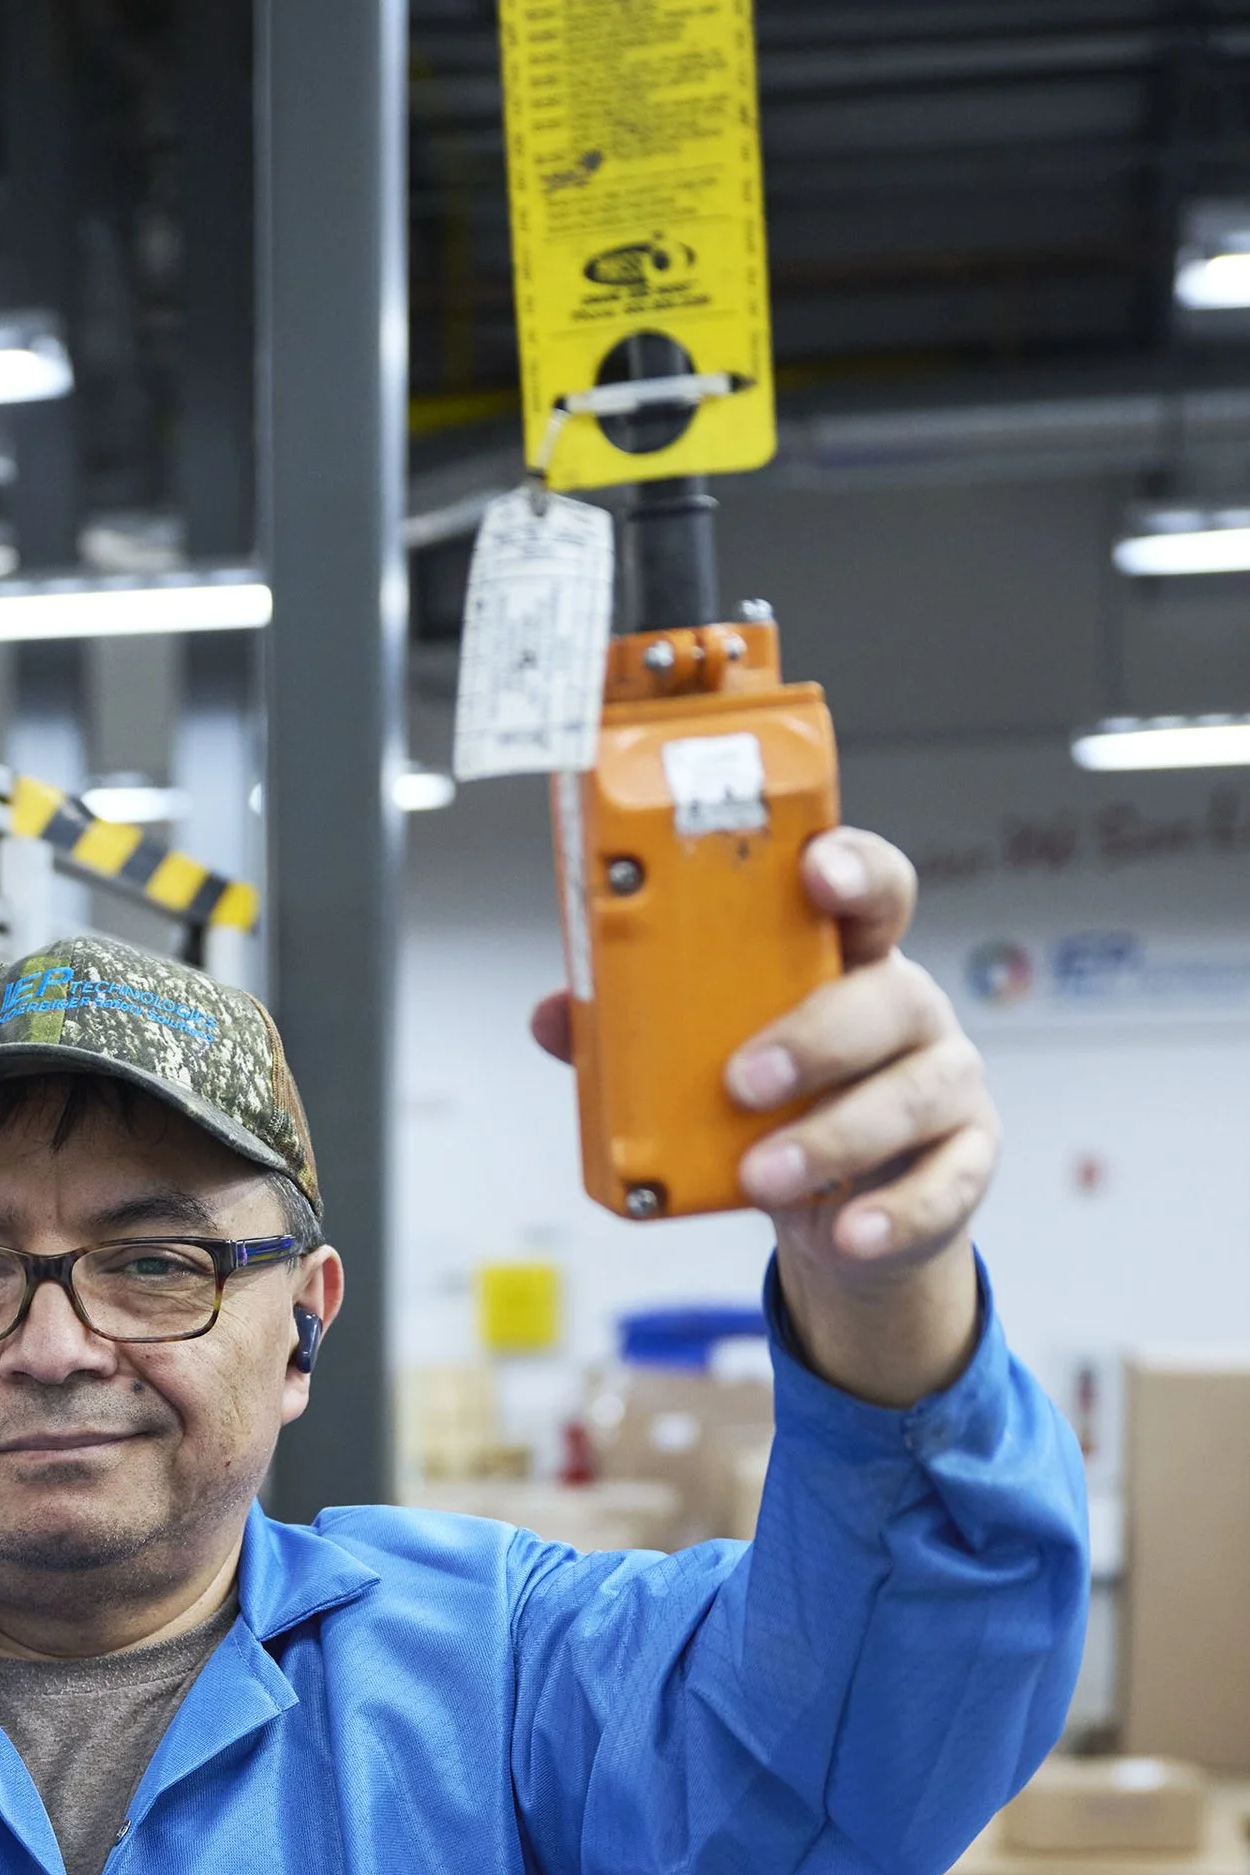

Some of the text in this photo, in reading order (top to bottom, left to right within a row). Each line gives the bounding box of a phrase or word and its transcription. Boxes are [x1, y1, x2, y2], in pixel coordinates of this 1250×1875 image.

[0, 966, 218, 1030] IEP TECHNOLOGIES
[94, 996, 144, 1017] Safety
[147, 1008, 215, 1044] Solutions
